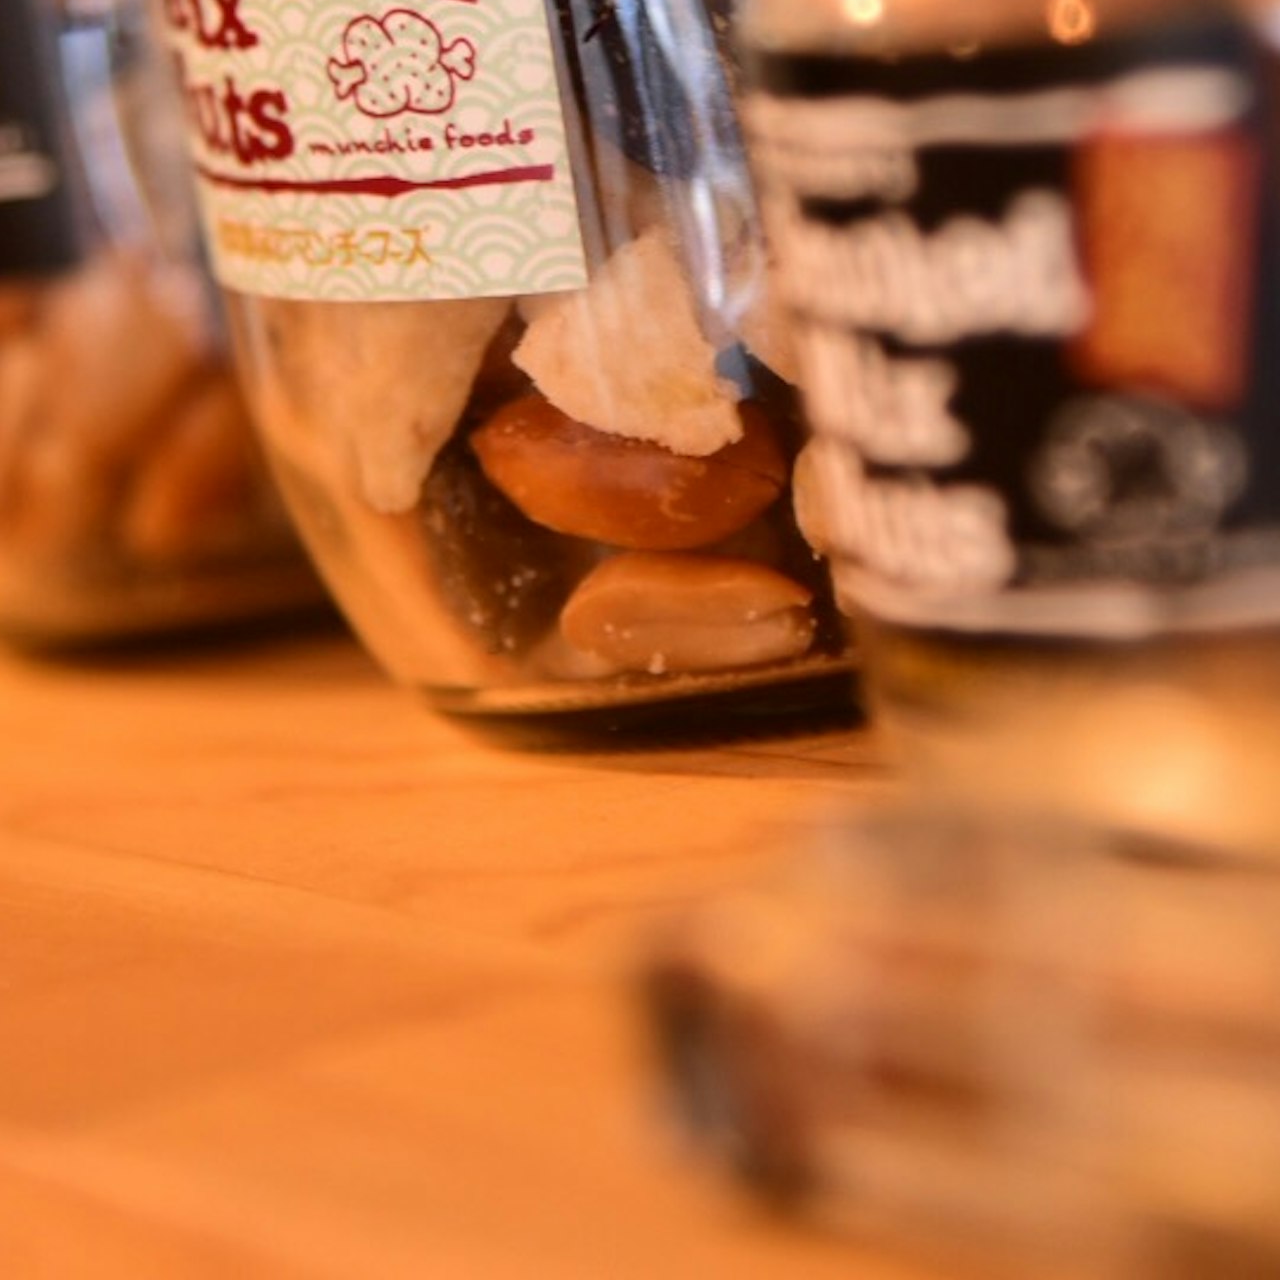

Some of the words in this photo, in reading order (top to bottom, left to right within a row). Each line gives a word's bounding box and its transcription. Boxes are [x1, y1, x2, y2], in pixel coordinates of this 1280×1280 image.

[170, 48, 295, 167] uts
[307, 127, 434, 156] munchie
[444, 118, 535, 150] foods
